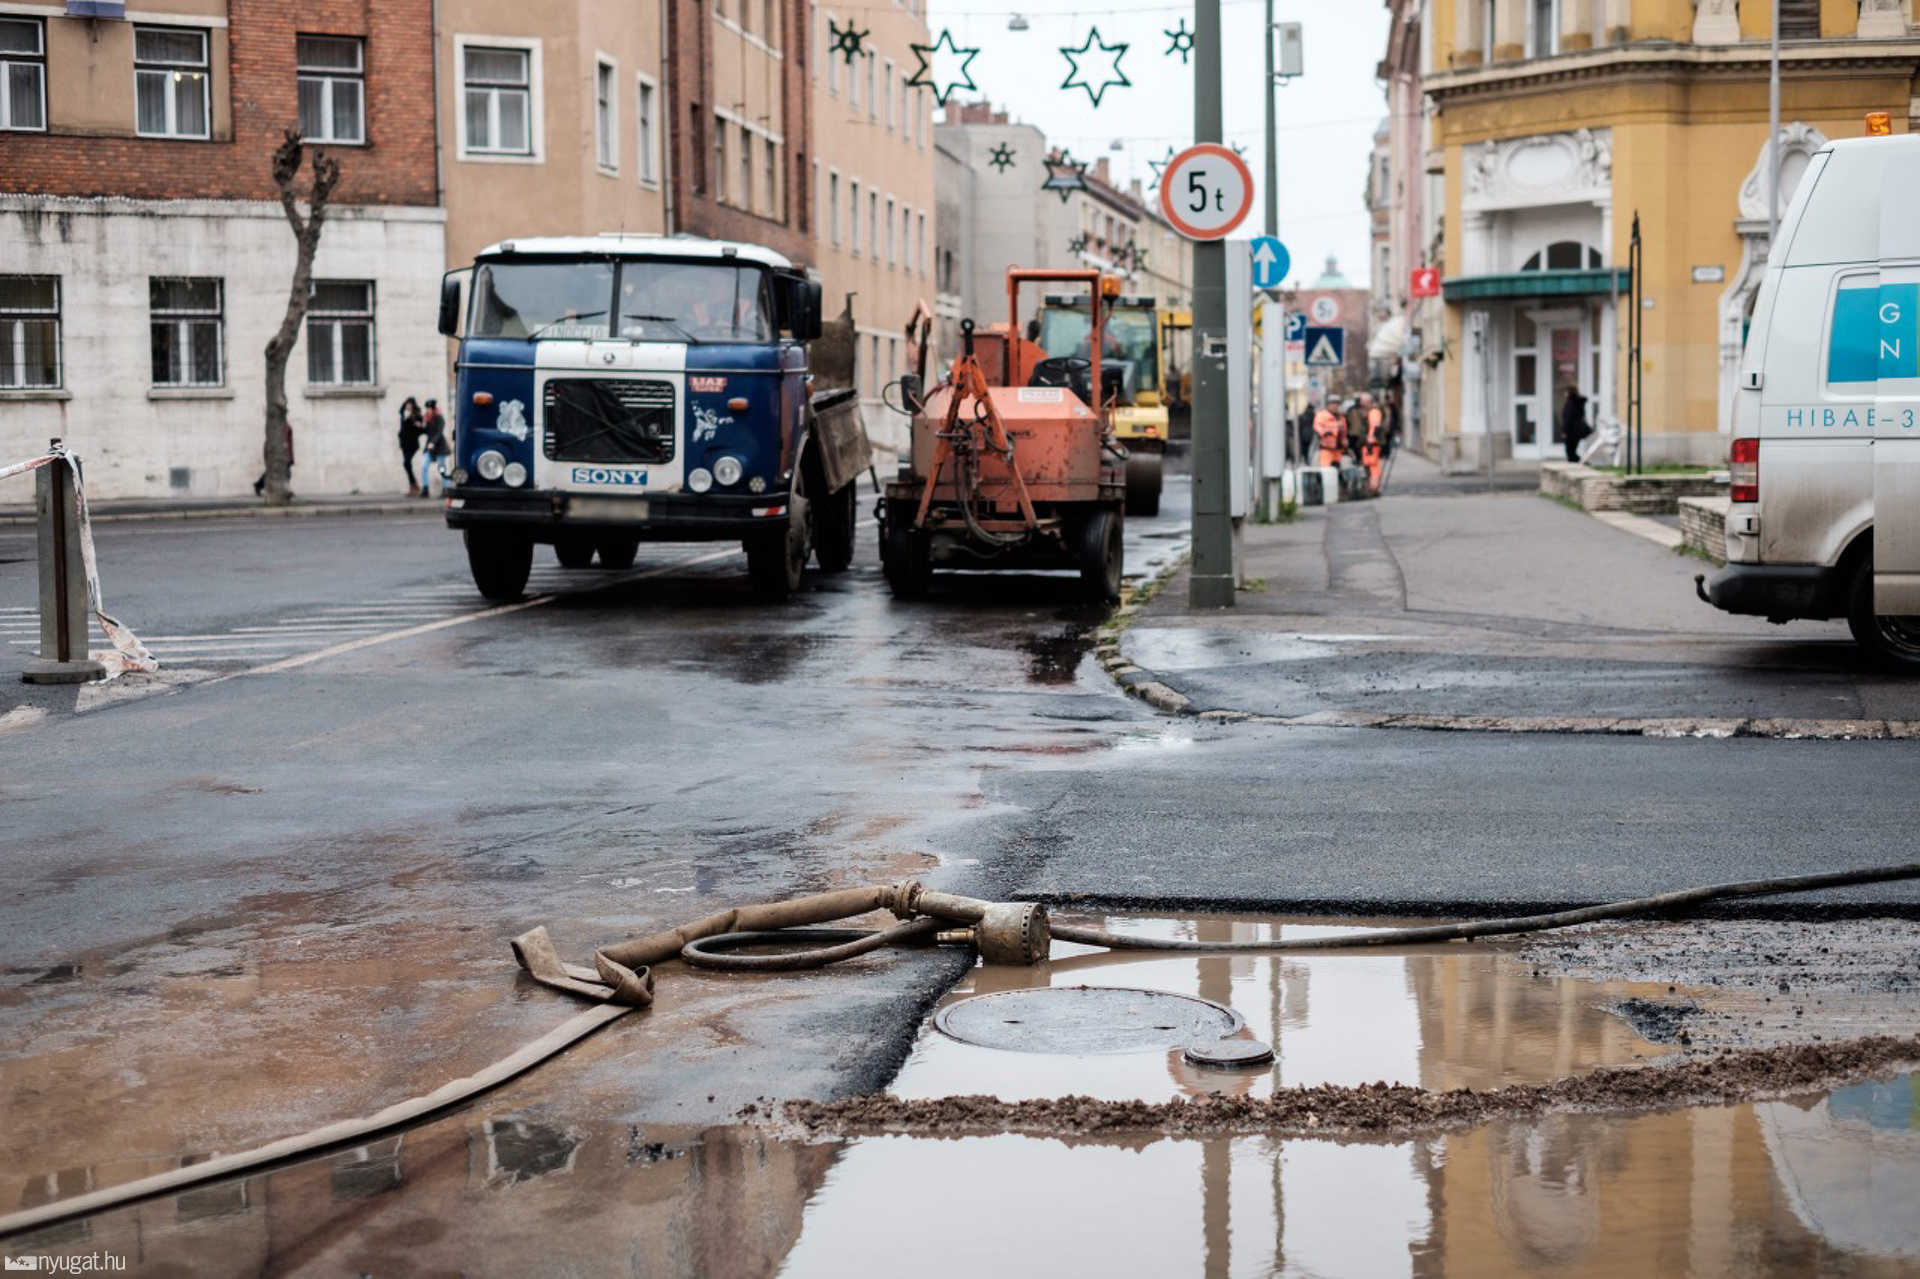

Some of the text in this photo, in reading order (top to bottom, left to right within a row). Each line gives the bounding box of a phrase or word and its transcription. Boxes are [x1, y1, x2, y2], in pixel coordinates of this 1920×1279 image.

[1189, 171, 1224, 212] 5 t
[1879, 302, 1900, 324] G
[1880, 338, 1900, 359] N
[575, 468, 646, 484] SONY
